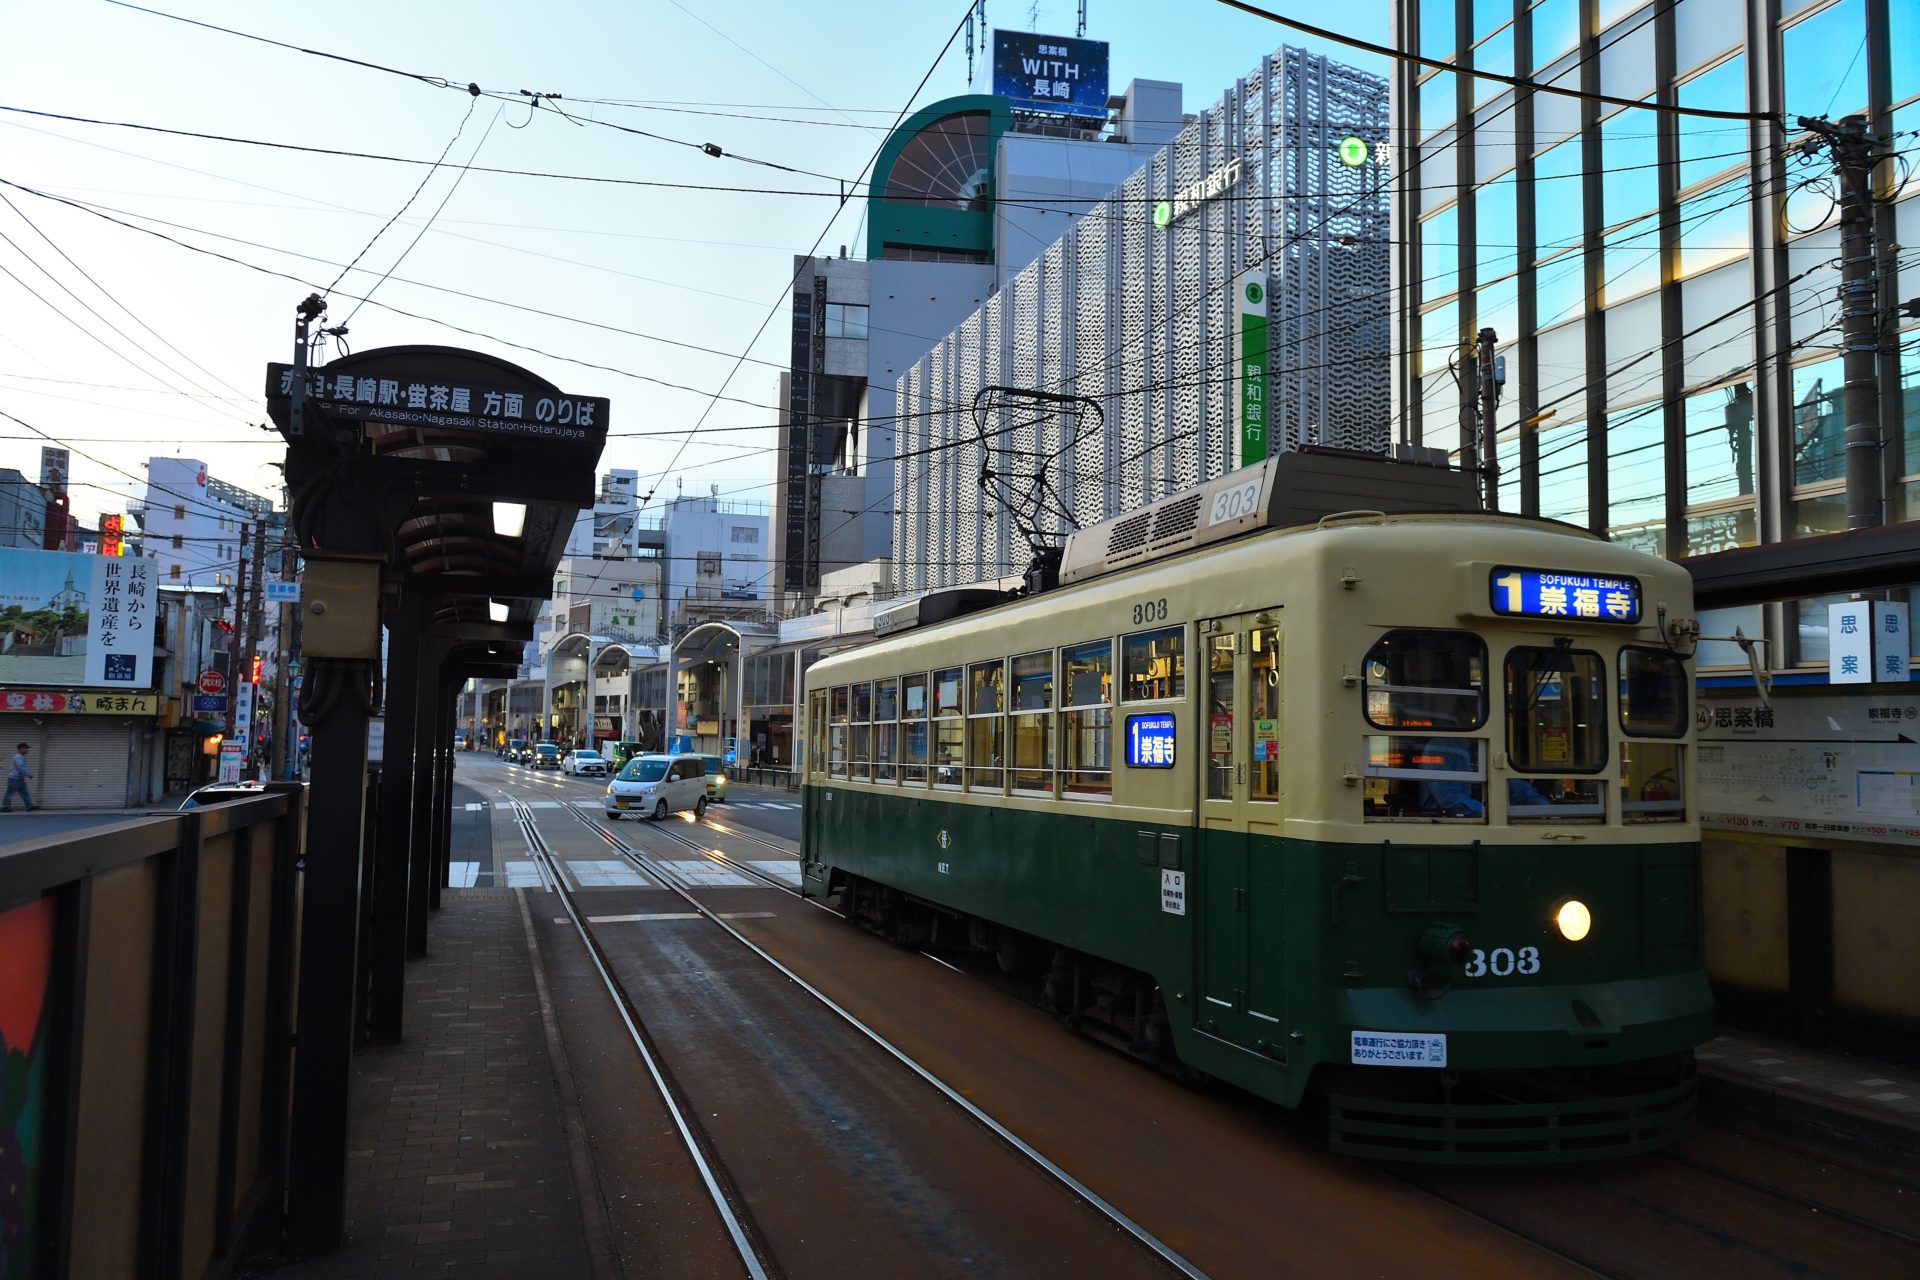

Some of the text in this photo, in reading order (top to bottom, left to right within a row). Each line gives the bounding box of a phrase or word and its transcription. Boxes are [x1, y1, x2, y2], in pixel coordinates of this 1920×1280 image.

[1038, 44, 1068, 57] 思案橋
[1022, 58, 1079, 80] WITH
[1033, 79, 1070, 99] 長崎
[1173, 157, 1241, 216] 親和銀行
[339, 405, 361, 415] For
[483, 391, 524, 418] 方面
[535, 398, 596, 426] のりば
[1246, 364, 1262, 441] 親和銀行
[1215, 485, 1256, 521] 303
[127, 564, 148, 631] 長崎から
[1496, 572, 1523, 613] 1
[1539, 574, 1631, 591] SOFUKUJI TEMPLE
[101, 562, 122, 647] 世界遺産を
[1133, 598, 1168, 625] 303
[1539, 586, 1632, 619] 崇福寺
[1840, 613, 1859, 676] 思案
[1884, 613, 1902, 676] 思案
[96, 697, 147, 711] 豚まん
[1715, 707, 1774, 728] 思案橋
[1132, 722, 1139, 764] 1
[1141, 736, 1174, 764] 崇福寺
[1165, 873, 1181, 886] 入口
[1465, 946, 1541, 978] 303
